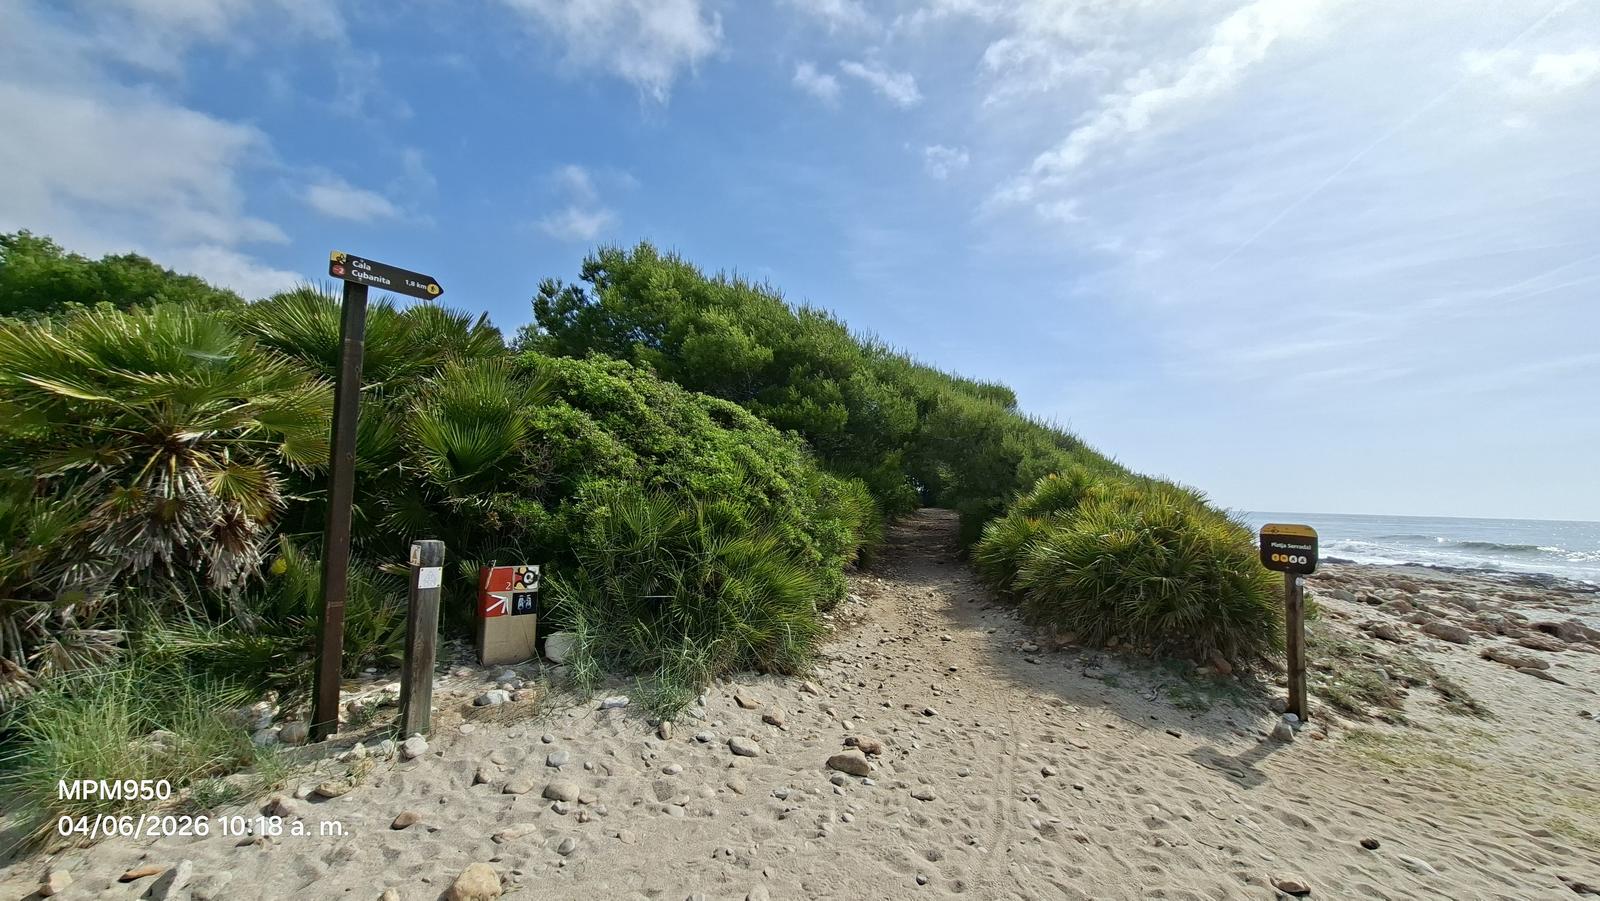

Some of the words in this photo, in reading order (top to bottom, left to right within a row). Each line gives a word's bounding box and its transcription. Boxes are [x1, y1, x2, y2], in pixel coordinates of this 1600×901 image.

[352, 260, 371, 271] Cala
[351, 269, 391, 285] Cubanita
[405, 279, 416, 287] 1,8
[416, 282, 427, 290] km
[505, 581, 511, 590] 2
